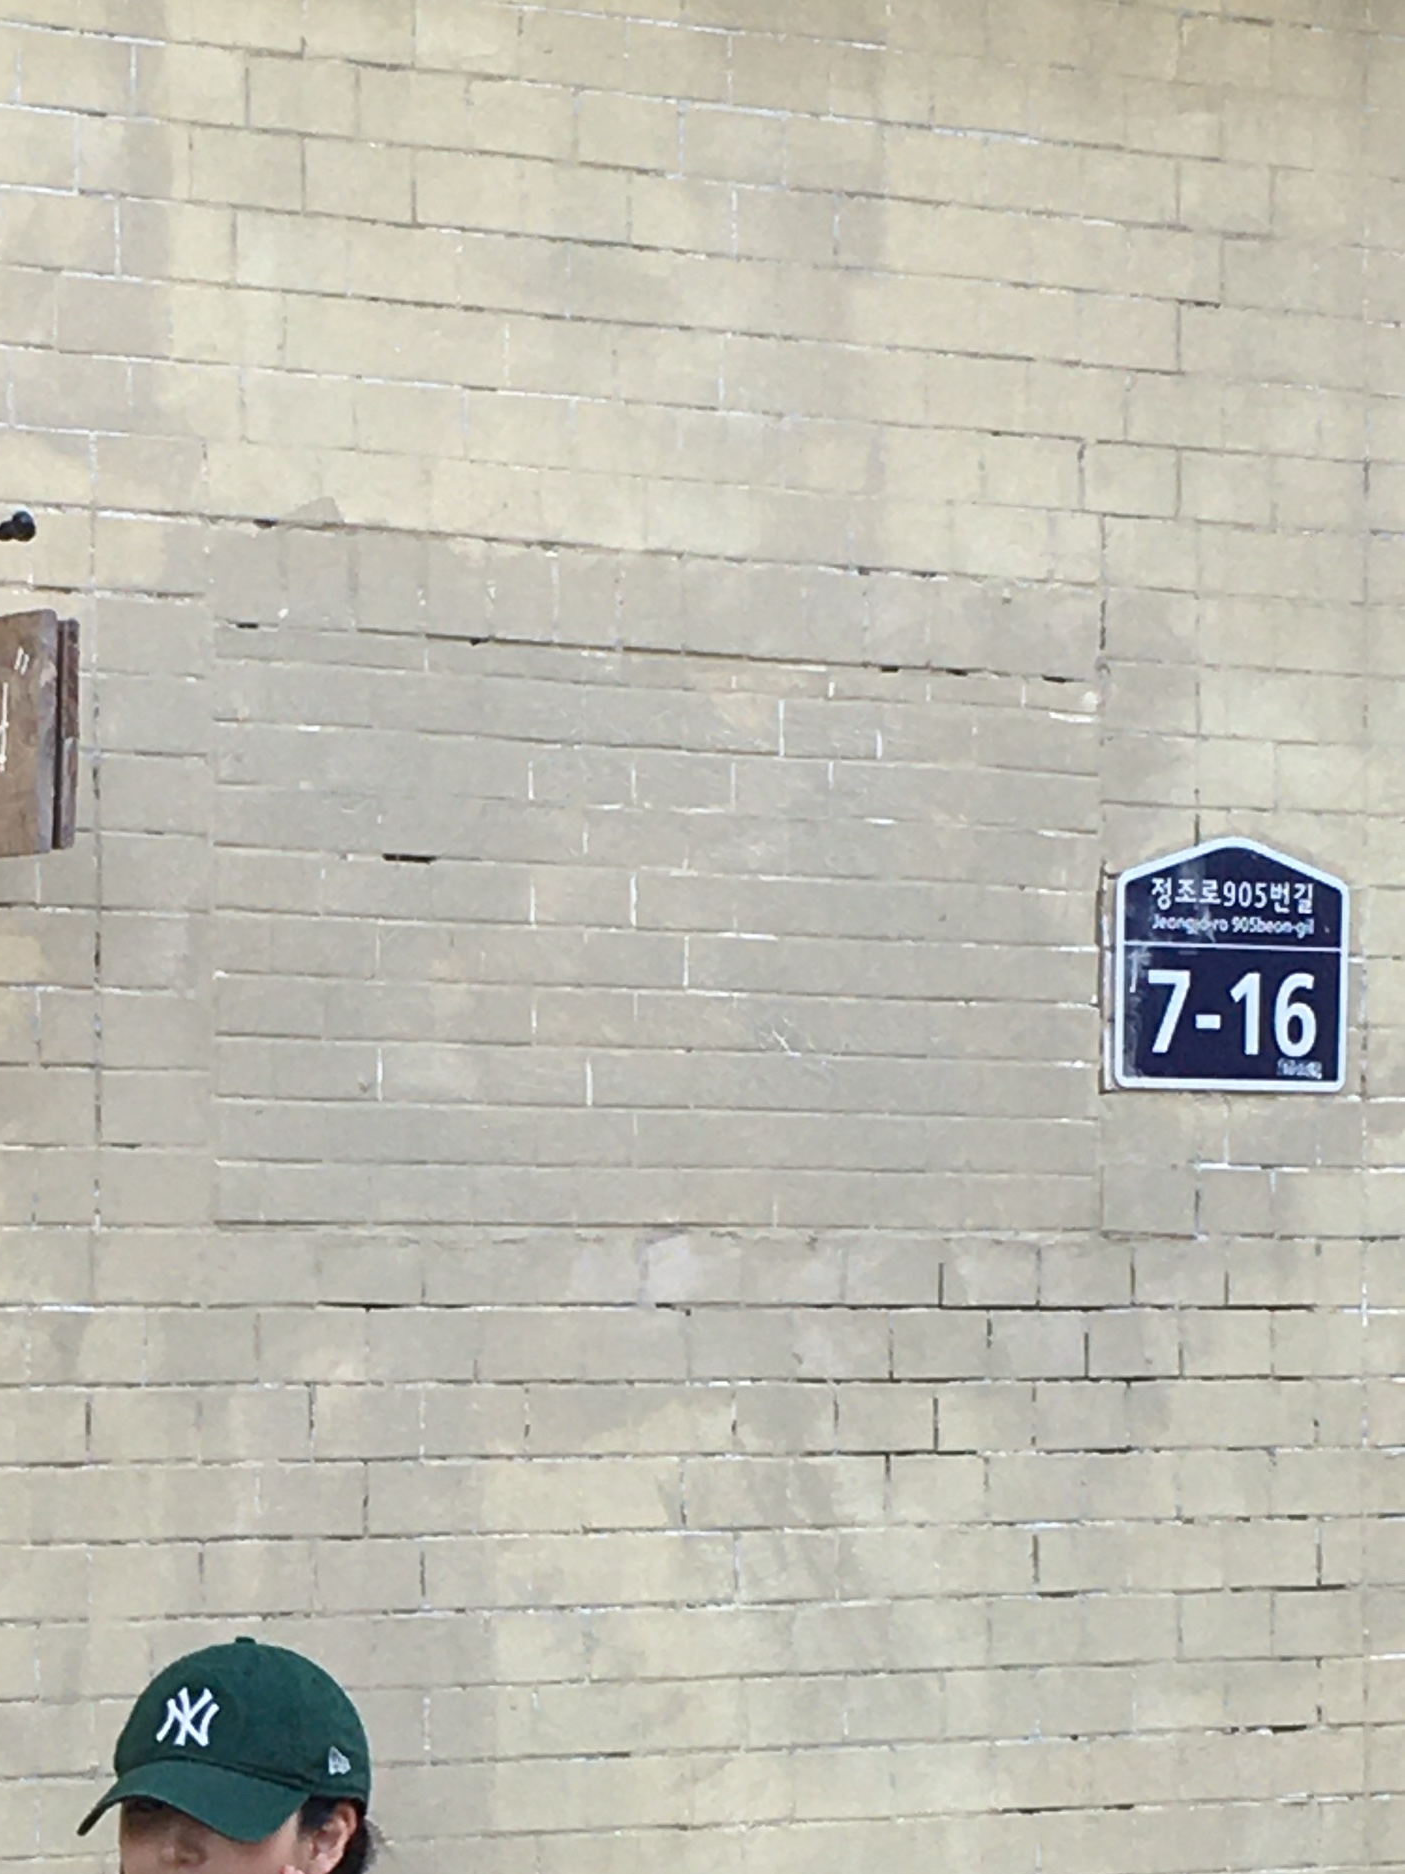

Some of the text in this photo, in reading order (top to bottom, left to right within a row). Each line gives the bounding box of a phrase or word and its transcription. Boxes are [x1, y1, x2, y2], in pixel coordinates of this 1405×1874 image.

[1151, 877, 1314, 914] 정조로905번길
[1231, 917, 1314, 939] 905beon-gil
[1148, 969, 1317, 1057] 7-16
